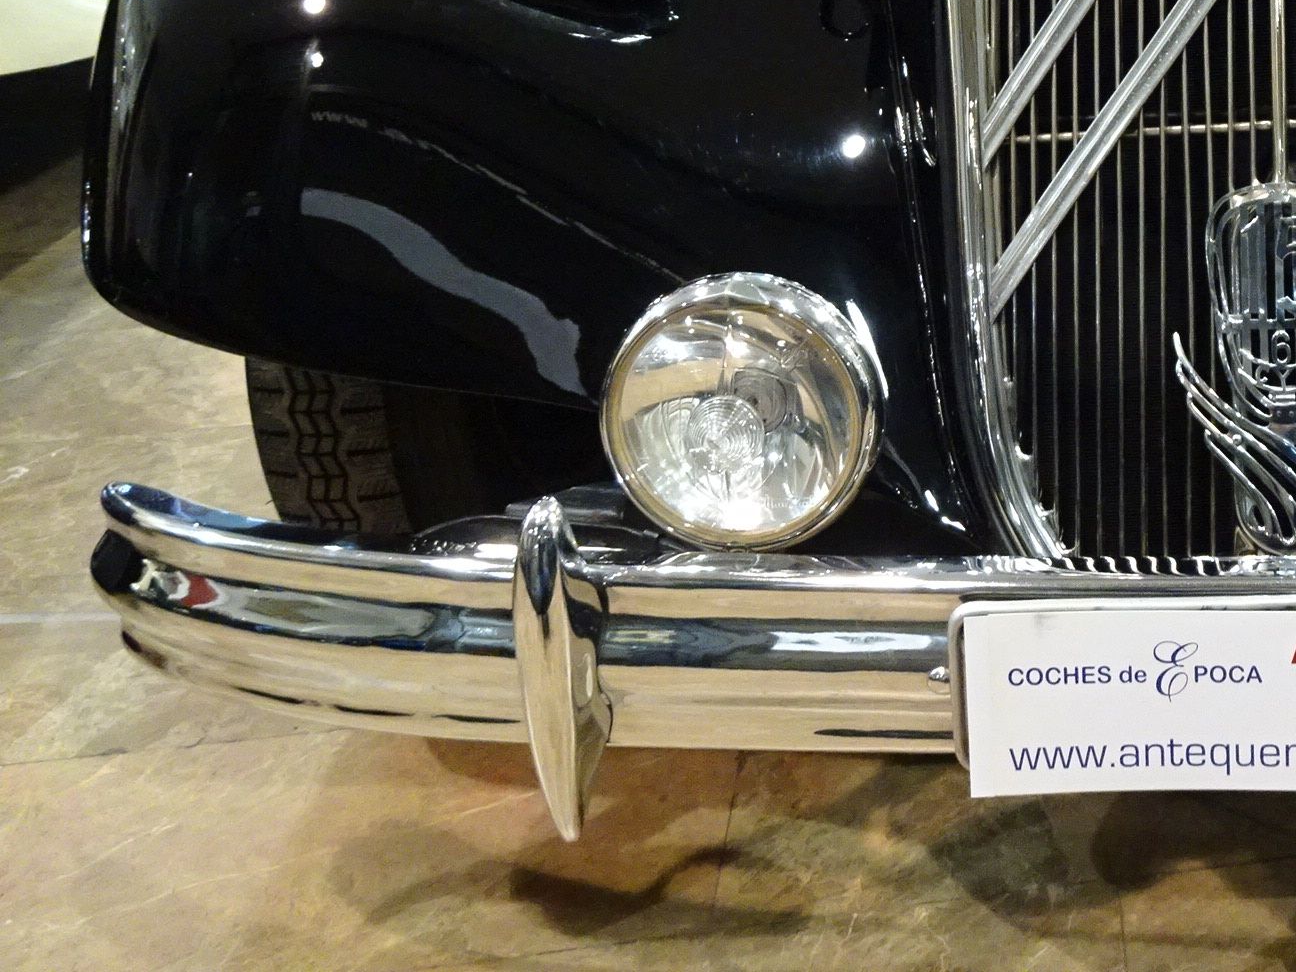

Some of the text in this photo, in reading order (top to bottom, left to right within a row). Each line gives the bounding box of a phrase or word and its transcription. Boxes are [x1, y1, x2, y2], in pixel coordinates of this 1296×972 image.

[1271, 329, 1292, 365] 6
[1007, 666, 1112, 686] COCHES
[1119, 665, 1147, 684] de
